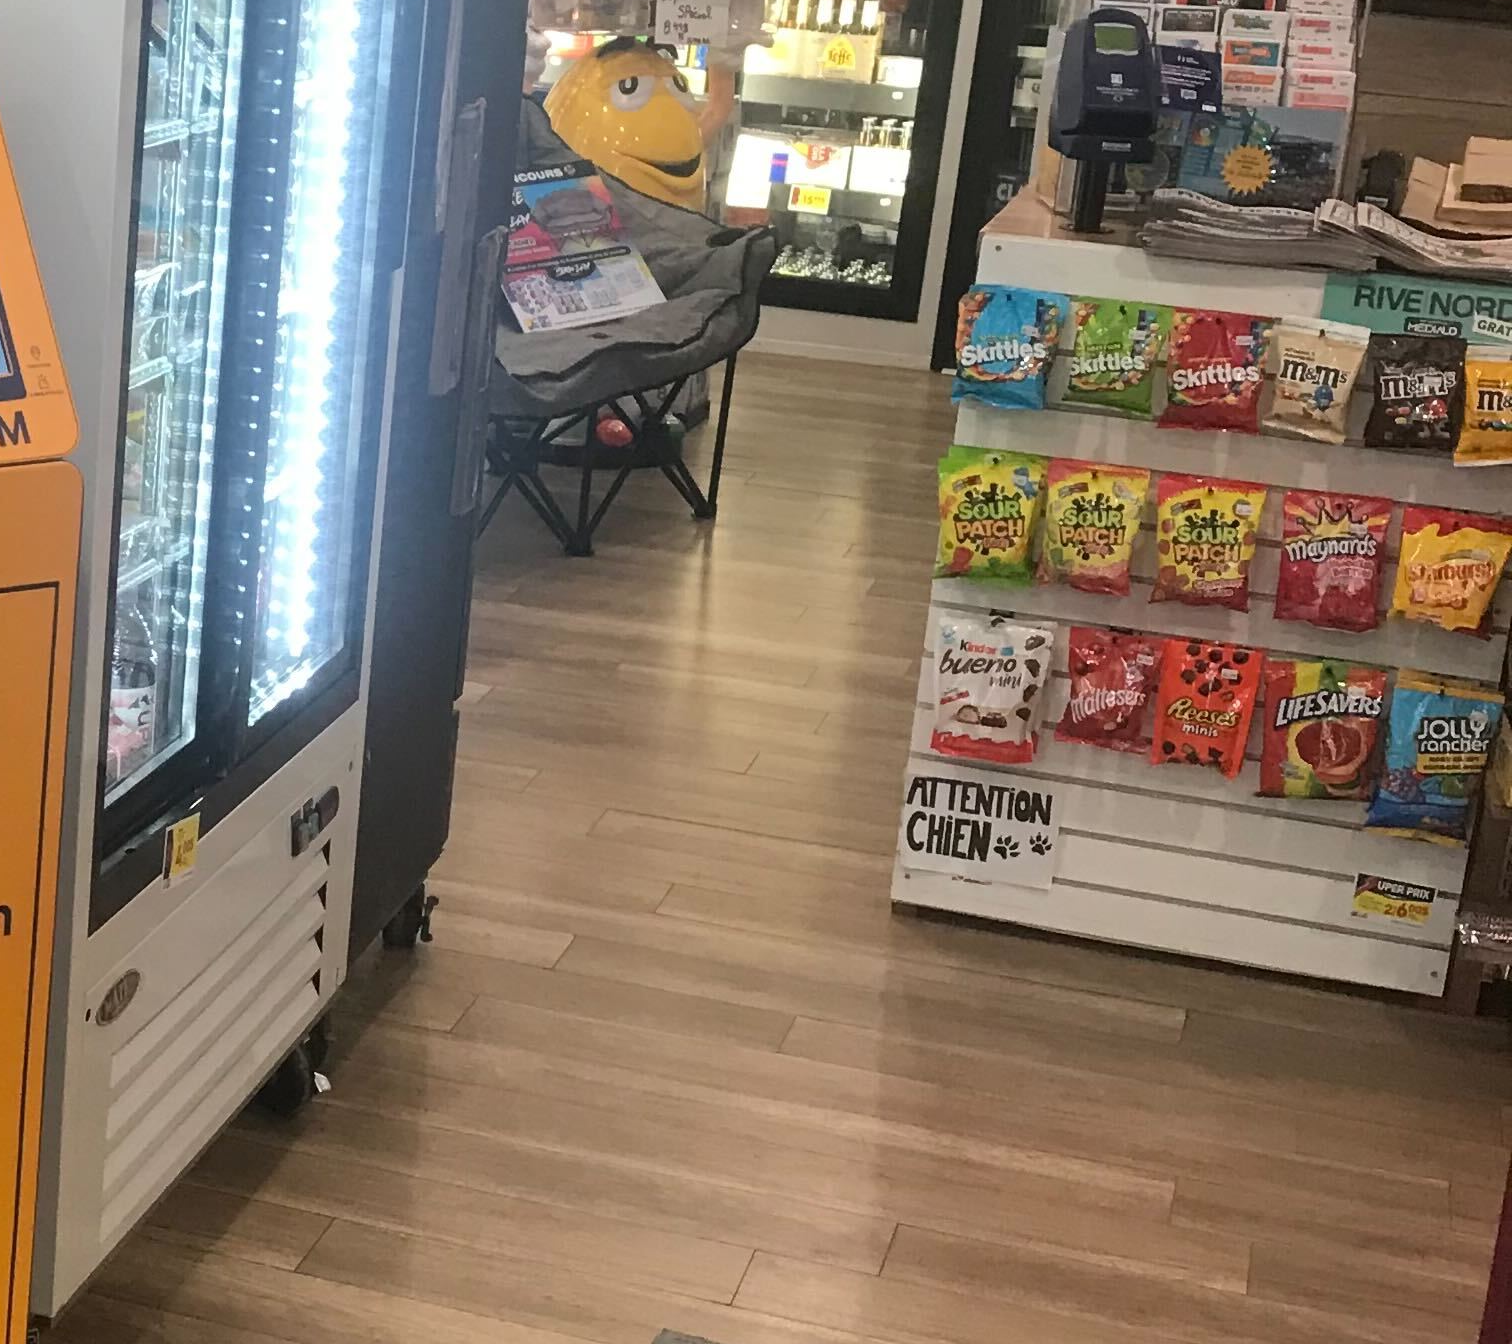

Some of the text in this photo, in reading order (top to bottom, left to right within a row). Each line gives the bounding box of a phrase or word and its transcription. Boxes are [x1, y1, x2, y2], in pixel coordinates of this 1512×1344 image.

[1353, 284, 1424, 314] RIVE
[960, 341, 1048, 367] Skittles
[1070, 353, 1146, 378] Skittles
[1172, 364, 1261, 391] Skittles
[958, 500, 1021, 520] SOUR
[1063, 507, 1123, 528] SOUR
[955, 519, 1024, 539] PATCH
[1059, 527, 1125, 546] PATCH
[1176, 526, 1238, 545] SOUR
[1174, 543, 1239, 563] PATCH
[939, 649, 1017, 676] bueno
[988, 673, 1023, 689] mini
[1070, 687, 1147, 724] maltesers
[1166, 697, 1241, 729] Reese's
[1181, 722, 1219, 738] minis
[1417, 717, 1488, 741] JOLLY
[1419, 738, 1490, 754] rancher
[1405, 887, 1431, 901] PRIX
